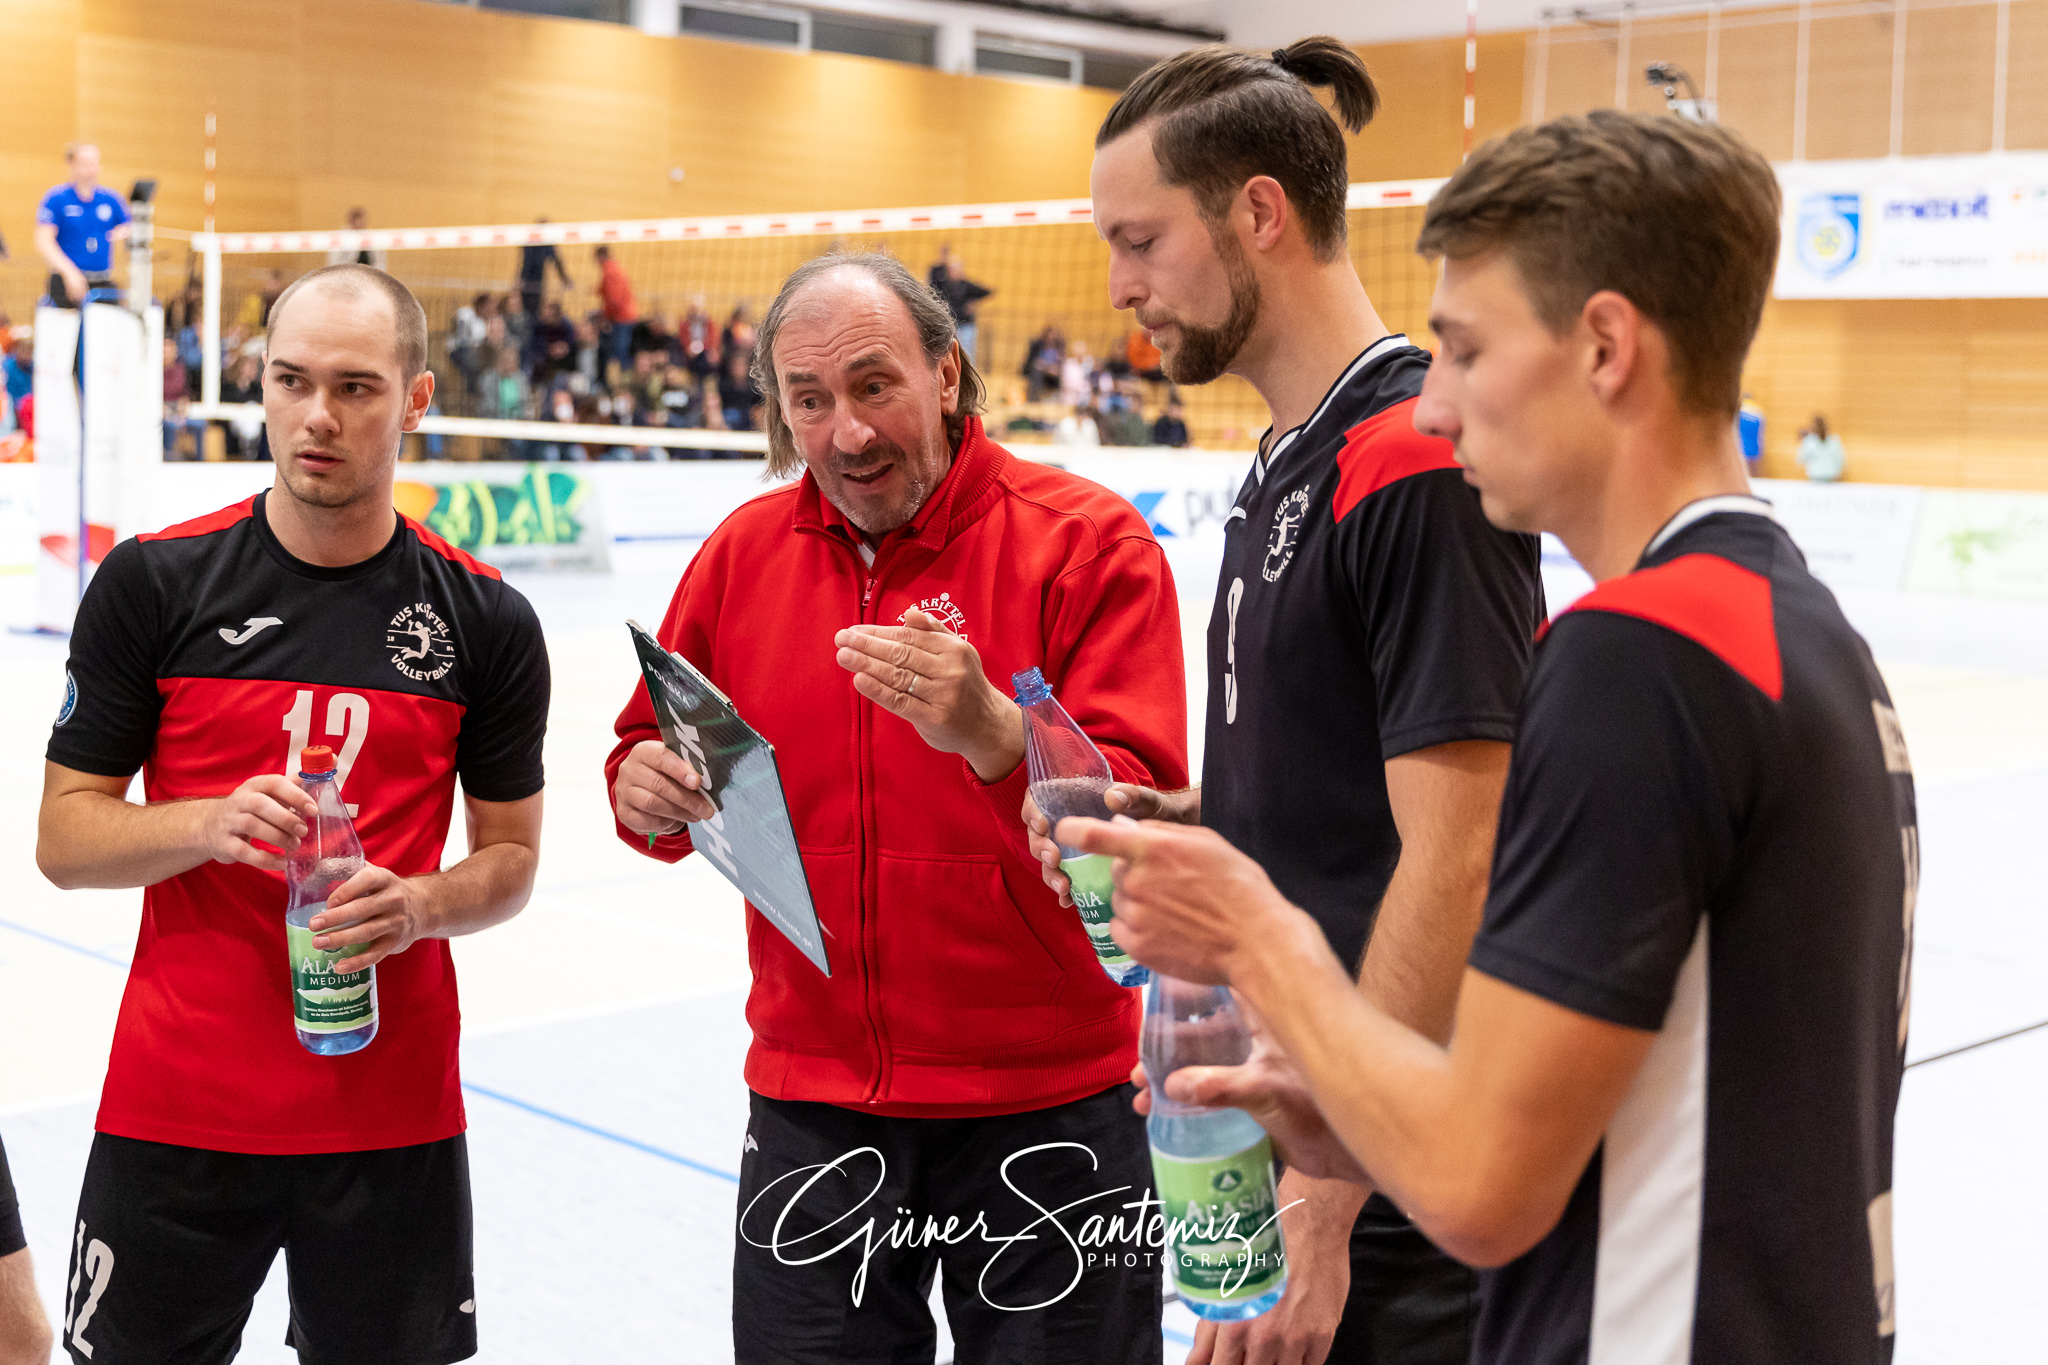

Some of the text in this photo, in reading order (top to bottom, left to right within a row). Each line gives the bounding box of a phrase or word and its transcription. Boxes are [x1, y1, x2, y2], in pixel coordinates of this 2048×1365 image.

[390, 606, 413, 627] TUS
[921, 597, 966, 628] KRIFTEL
[391, 653, 453, 681] VOLLEYBALL
[646, 661, 691, 708] POLSKA
[282, 690, 370, 819] 12
[310, 972, 361, 986] MEDIUM
